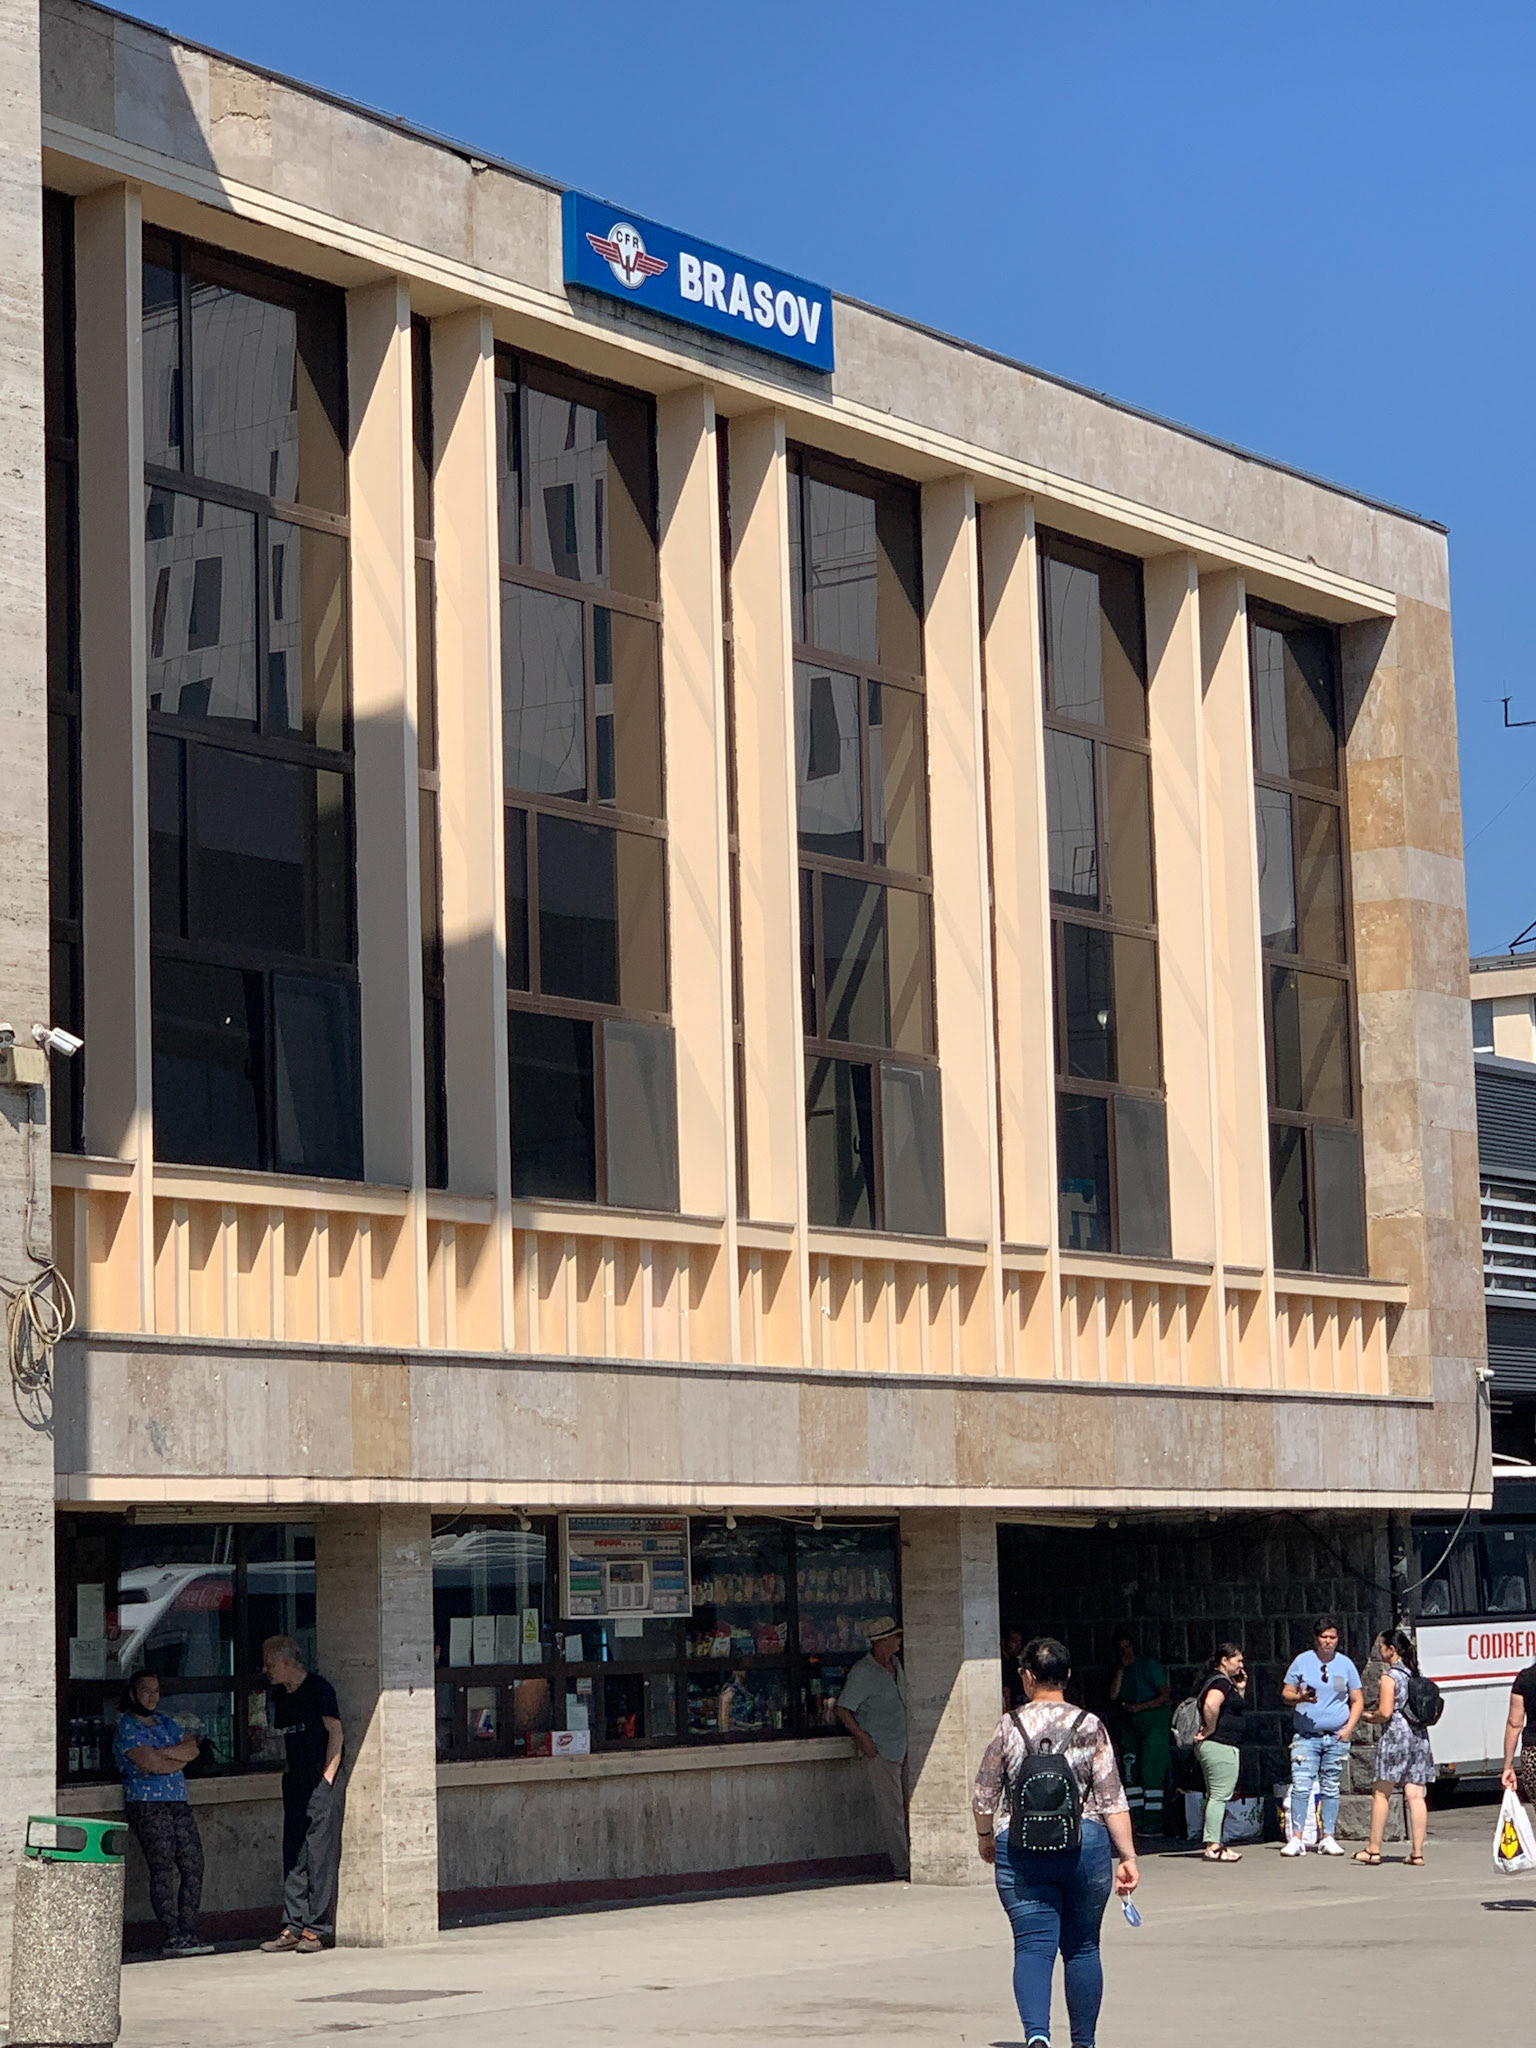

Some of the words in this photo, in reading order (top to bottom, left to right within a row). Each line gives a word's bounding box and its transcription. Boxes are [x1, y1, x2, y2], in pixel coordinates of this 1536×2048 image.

[616, 230, 639, 249] CFR
[679, 251, 822, 345] BRASOV
[1468, 1631, 1536, 1660] CODREA
